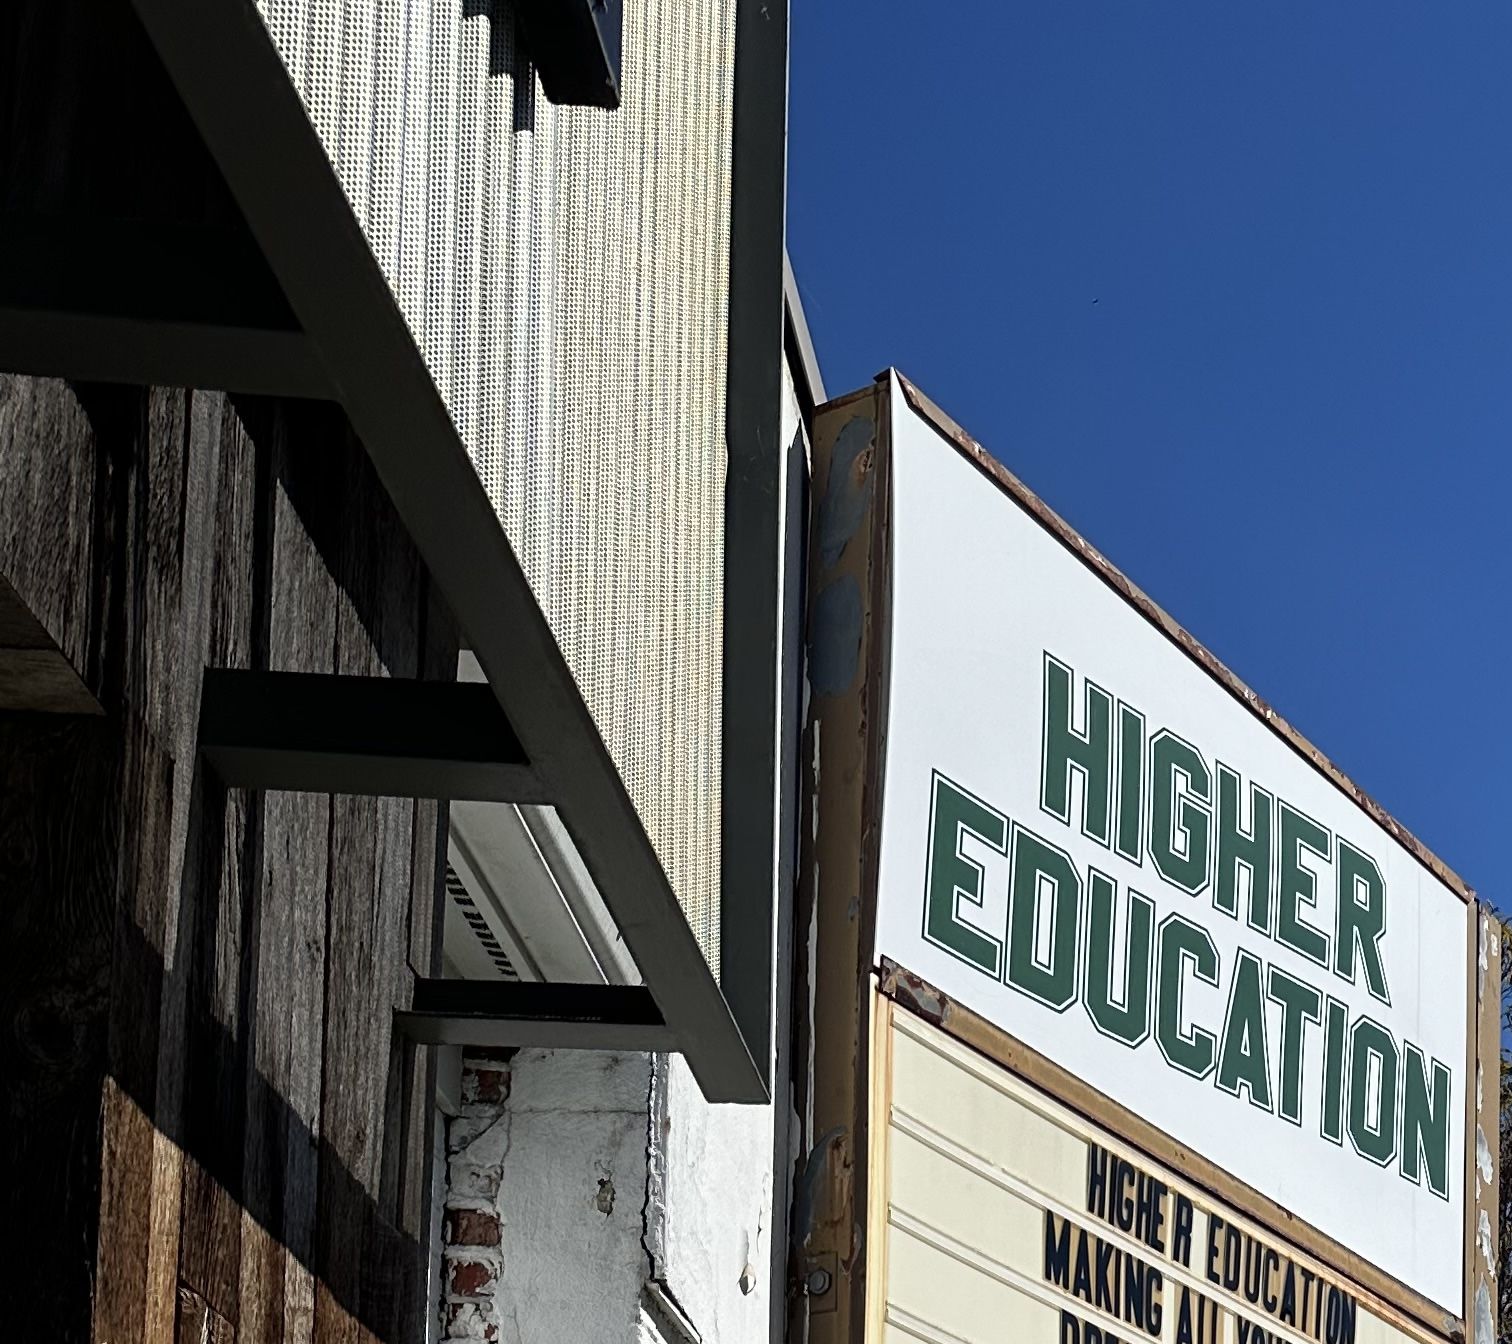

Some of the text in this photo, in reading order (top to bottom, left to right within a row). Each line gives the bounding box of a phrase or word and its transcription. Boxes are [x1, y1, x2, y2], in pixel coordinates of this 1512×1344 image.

[1040, 650, 1392, 1007] HIGHER
[922, 768, 1451, 1202] EDUCATION
[1044, 1210, 1163, 1338] MAKING
[1087, 1142, 1193, 1269] HIGHER
